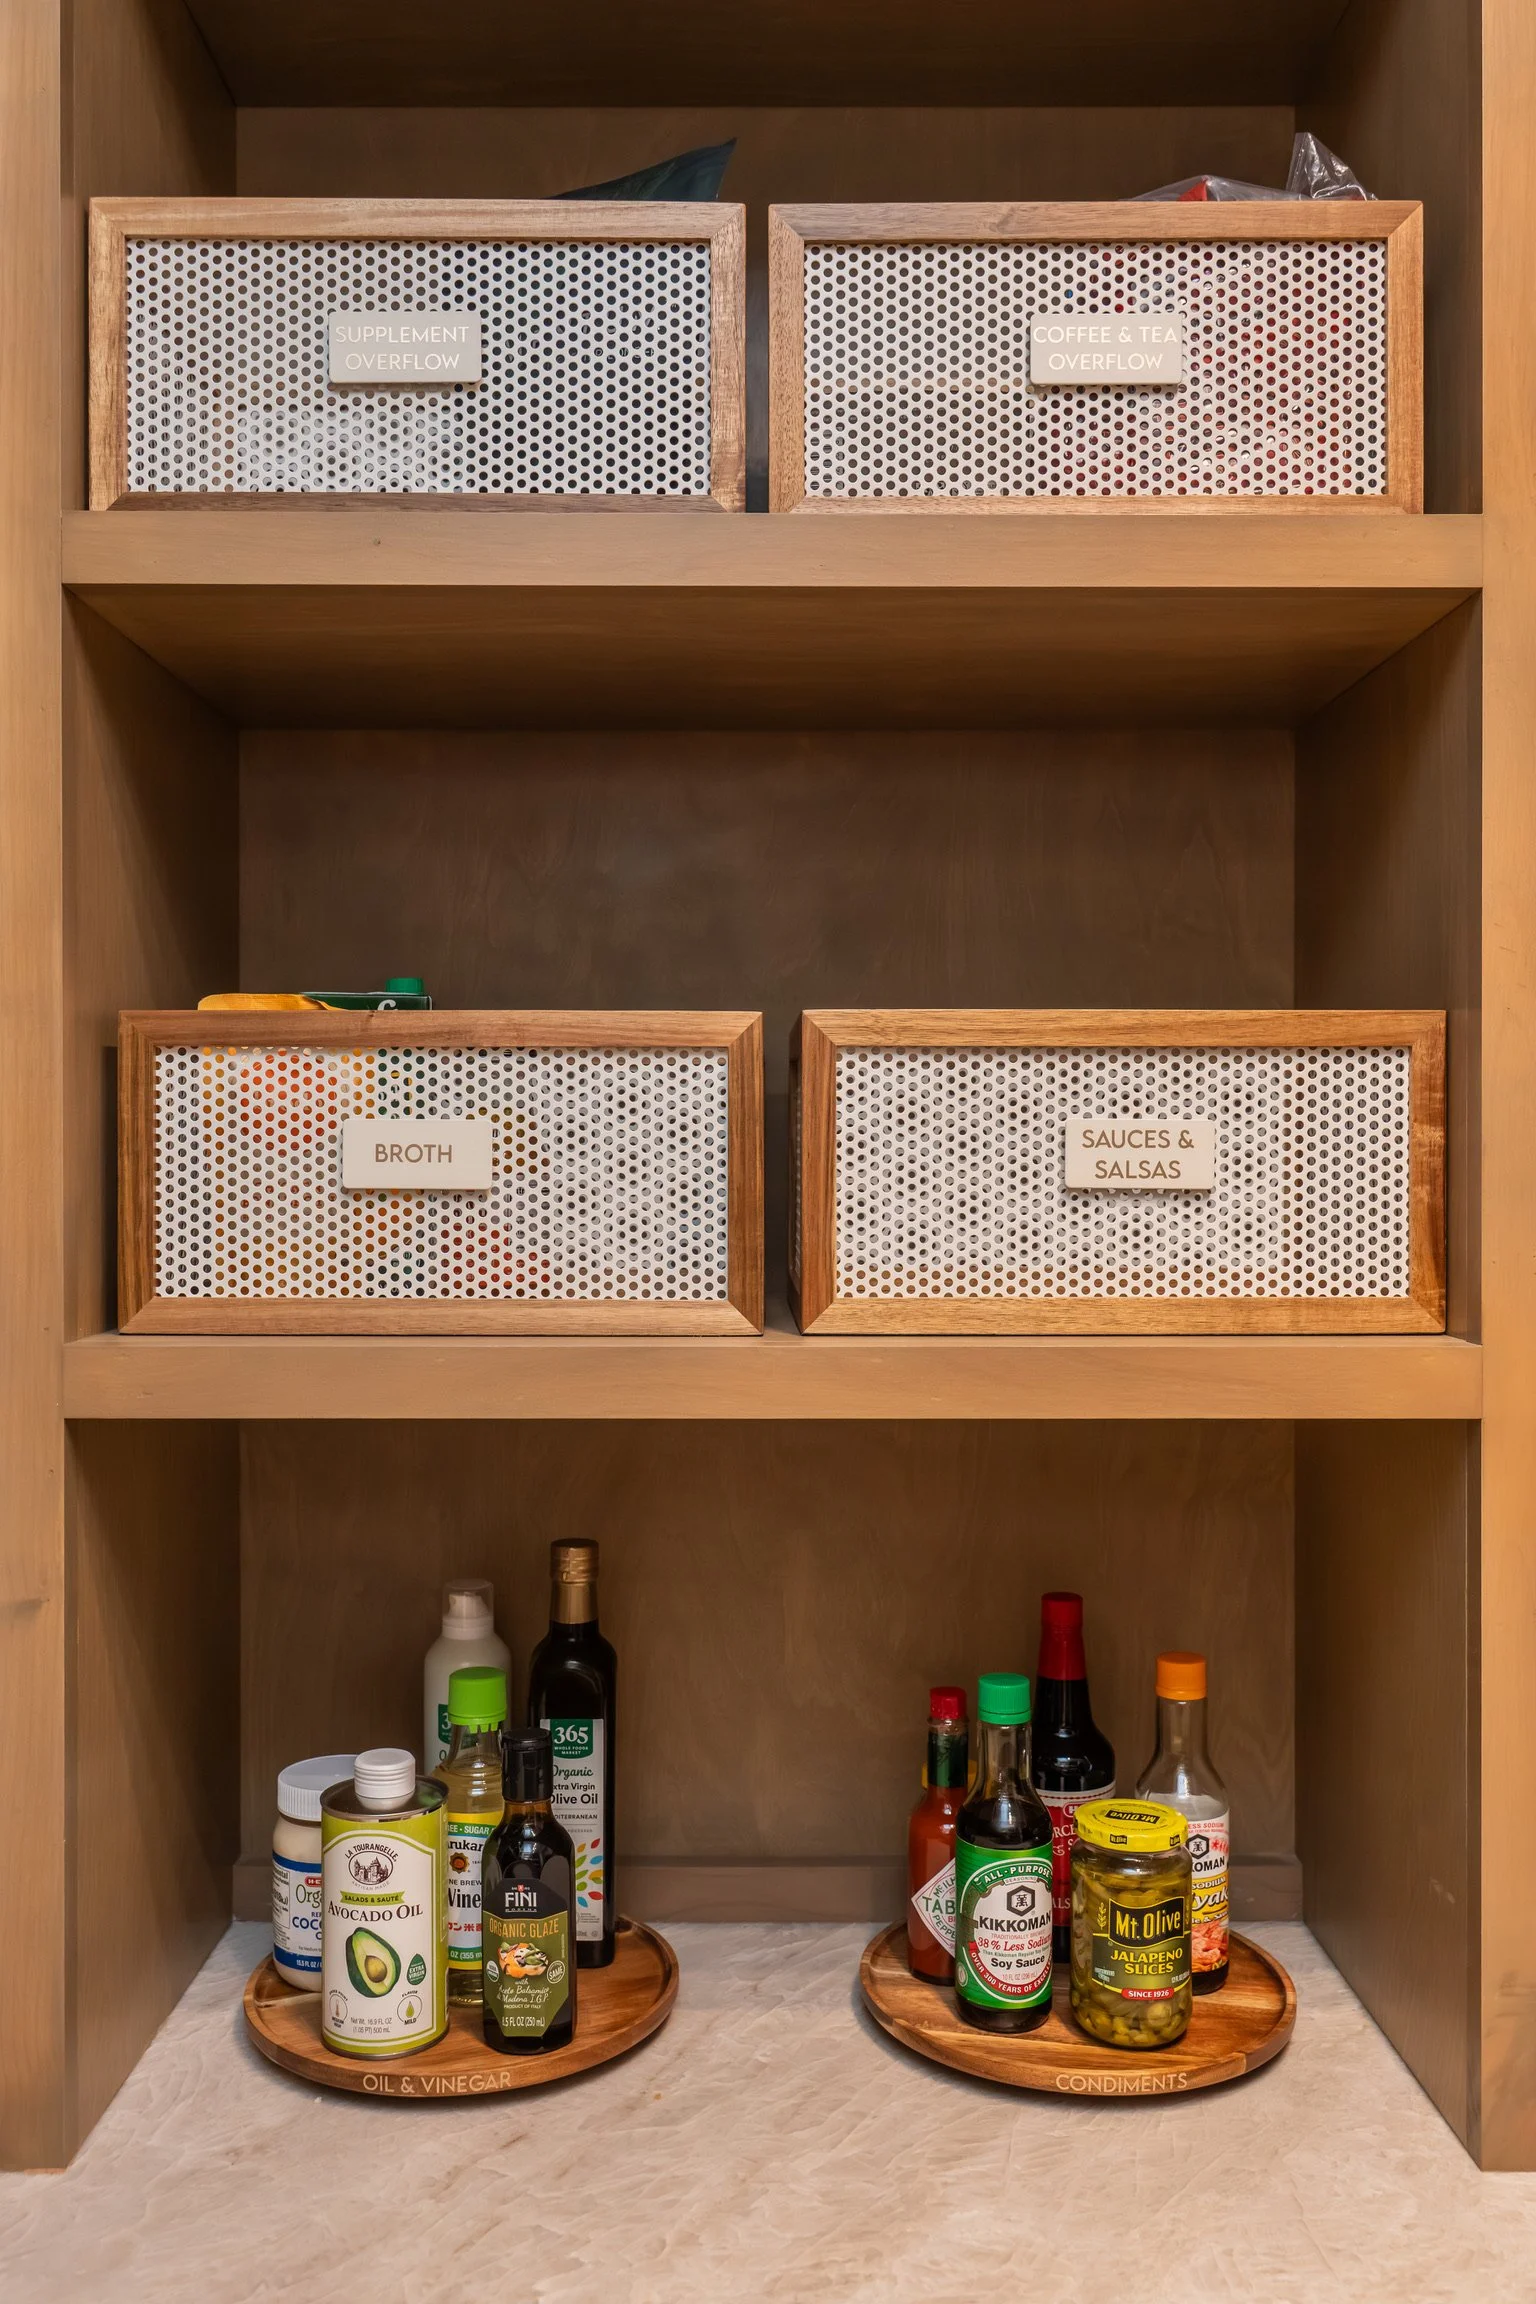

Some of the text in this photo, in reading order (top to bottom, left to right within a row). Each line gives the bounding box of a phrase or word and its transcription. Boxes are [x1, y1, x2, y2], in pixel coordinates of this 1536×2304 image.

[335, 326, 469, 343] SUPPLEMENT
[1033, 326, 1178, 343] COFFEE & TEA
[345, 353, 460, 370] OVERFLOW
[1048, 353, 1164, 370] OVERFLOW
[1082, 1129, 1195, 1149] SAUCES &
[375, 1143, 452, 1163] BROTH
[1094, 1160, 1181, 1179] SALSAS
[554, 1724, 589, 1744] 365
[571, 1782, 595, 1791] Virgin
[581, 1793, 598, 1804] Oil
[464, 1826, 490, 1834] SUGAR
[345, 1844, 399, 1861] LA TOURANGELLE
[344, 1895, 369, 1903] SALADS
[505, 1892, 536, 1907] FINI
[490, 1918, 559, 1938] ORGANIC GLAZE
[979, 1910, 1051, 1932] KIKKOMAN
[1116, 1909, 1180, 1939] Mt. Olive
[1004, 1941, 1025, 1951] Less
[991, 1955, 1045, 1970] Soy Sauce
[1111, 1948, 1183, 1963] JALAPENO
[971, 1952, 984, 1973] OVER
[983, 1973, 996, 1985] 300
[998, 1983, 1022, 1994] YEARS
[1024, 1984, 1032, 1993] OF
[1124, 1962, 1174, 1975] SLICES
[1128, 1989, 1169, 1998] SINCE 1926
[516, 2017, 524, 2026] OZ
[362, 2071, 512, 2094] OIL & VINEGAR
[1056, 2072, 1187, 2093] CONDIMENTS
